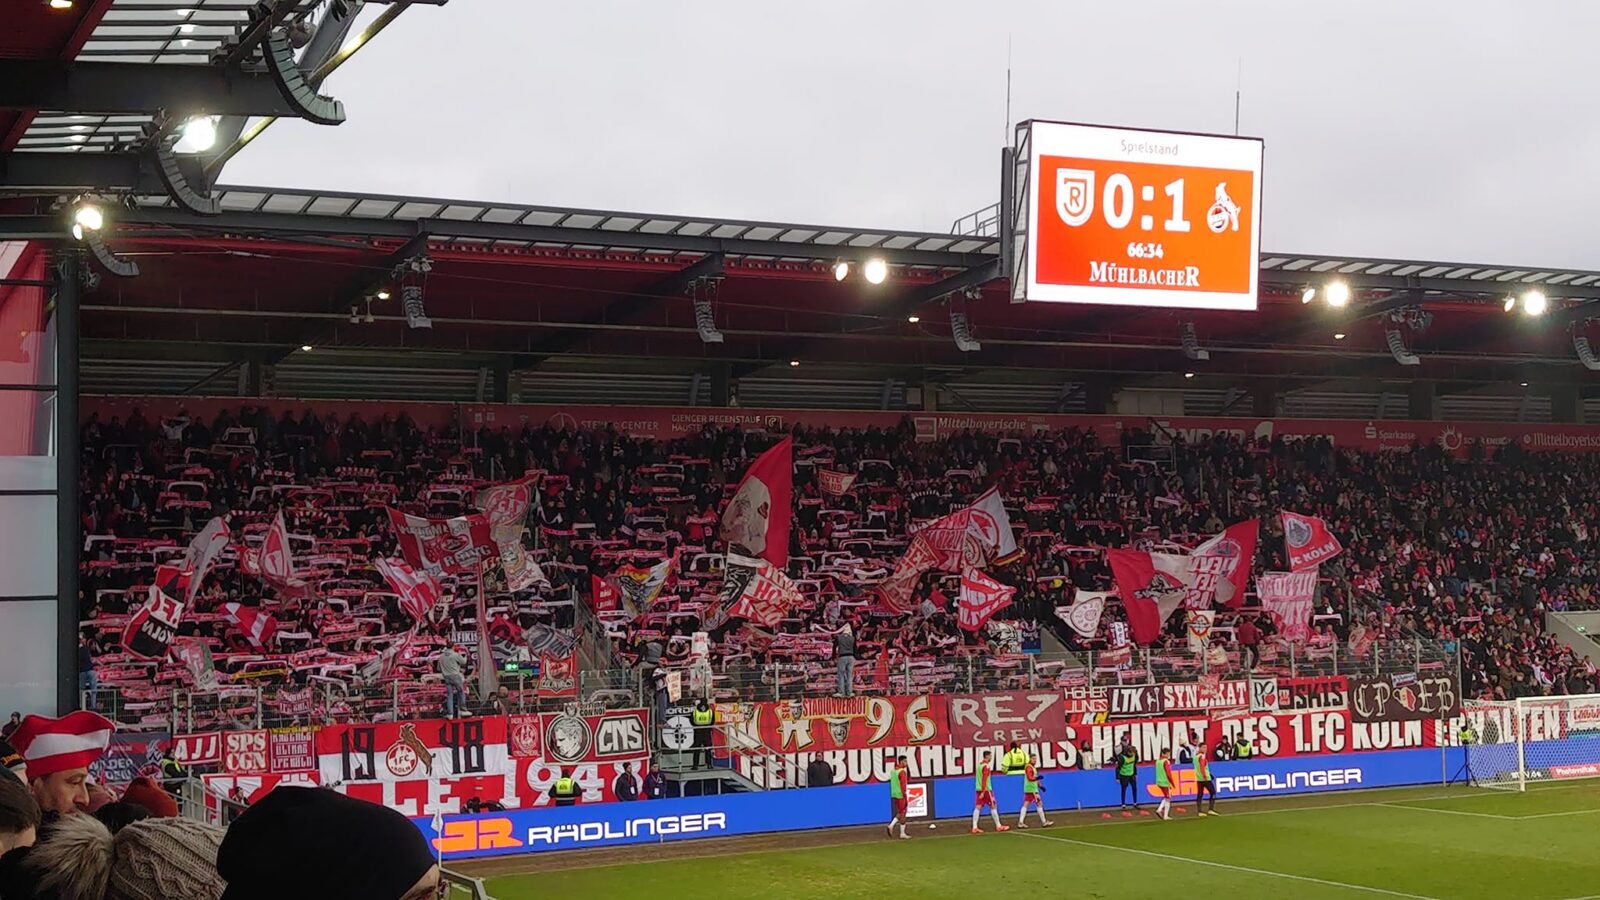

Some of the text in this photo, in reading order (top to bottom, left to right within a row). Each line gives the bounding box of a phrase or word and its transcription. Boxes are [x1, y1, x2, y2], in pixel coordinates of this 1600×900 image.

[1121, 139, 1178, 156] Spielstand
[1102, 173, 1191, 233] 0:1
[1127, 242, 1164, 259] 66:34
[1089, 261, 1200, 287] MÜHLBACHER
[1111, 688, 1146, 713] LTK
[174, 735, 217, 761] AJJ
[226, 731, 266, 753] SPS
[598, 718, 643, 753] CNS
[972, 727, 1042, 743] CREW
[1092, 719, 1208, 765] HEIMAT
[1222, 715, 1279, 757] DES
[1289, 712, 1345, 752] 1.FC
[226, 751, 266, 771] CGN
[1215, 767, 1362, 794] RÄDLINGER
[527, 812, 726, 846] RÄDLINGER
